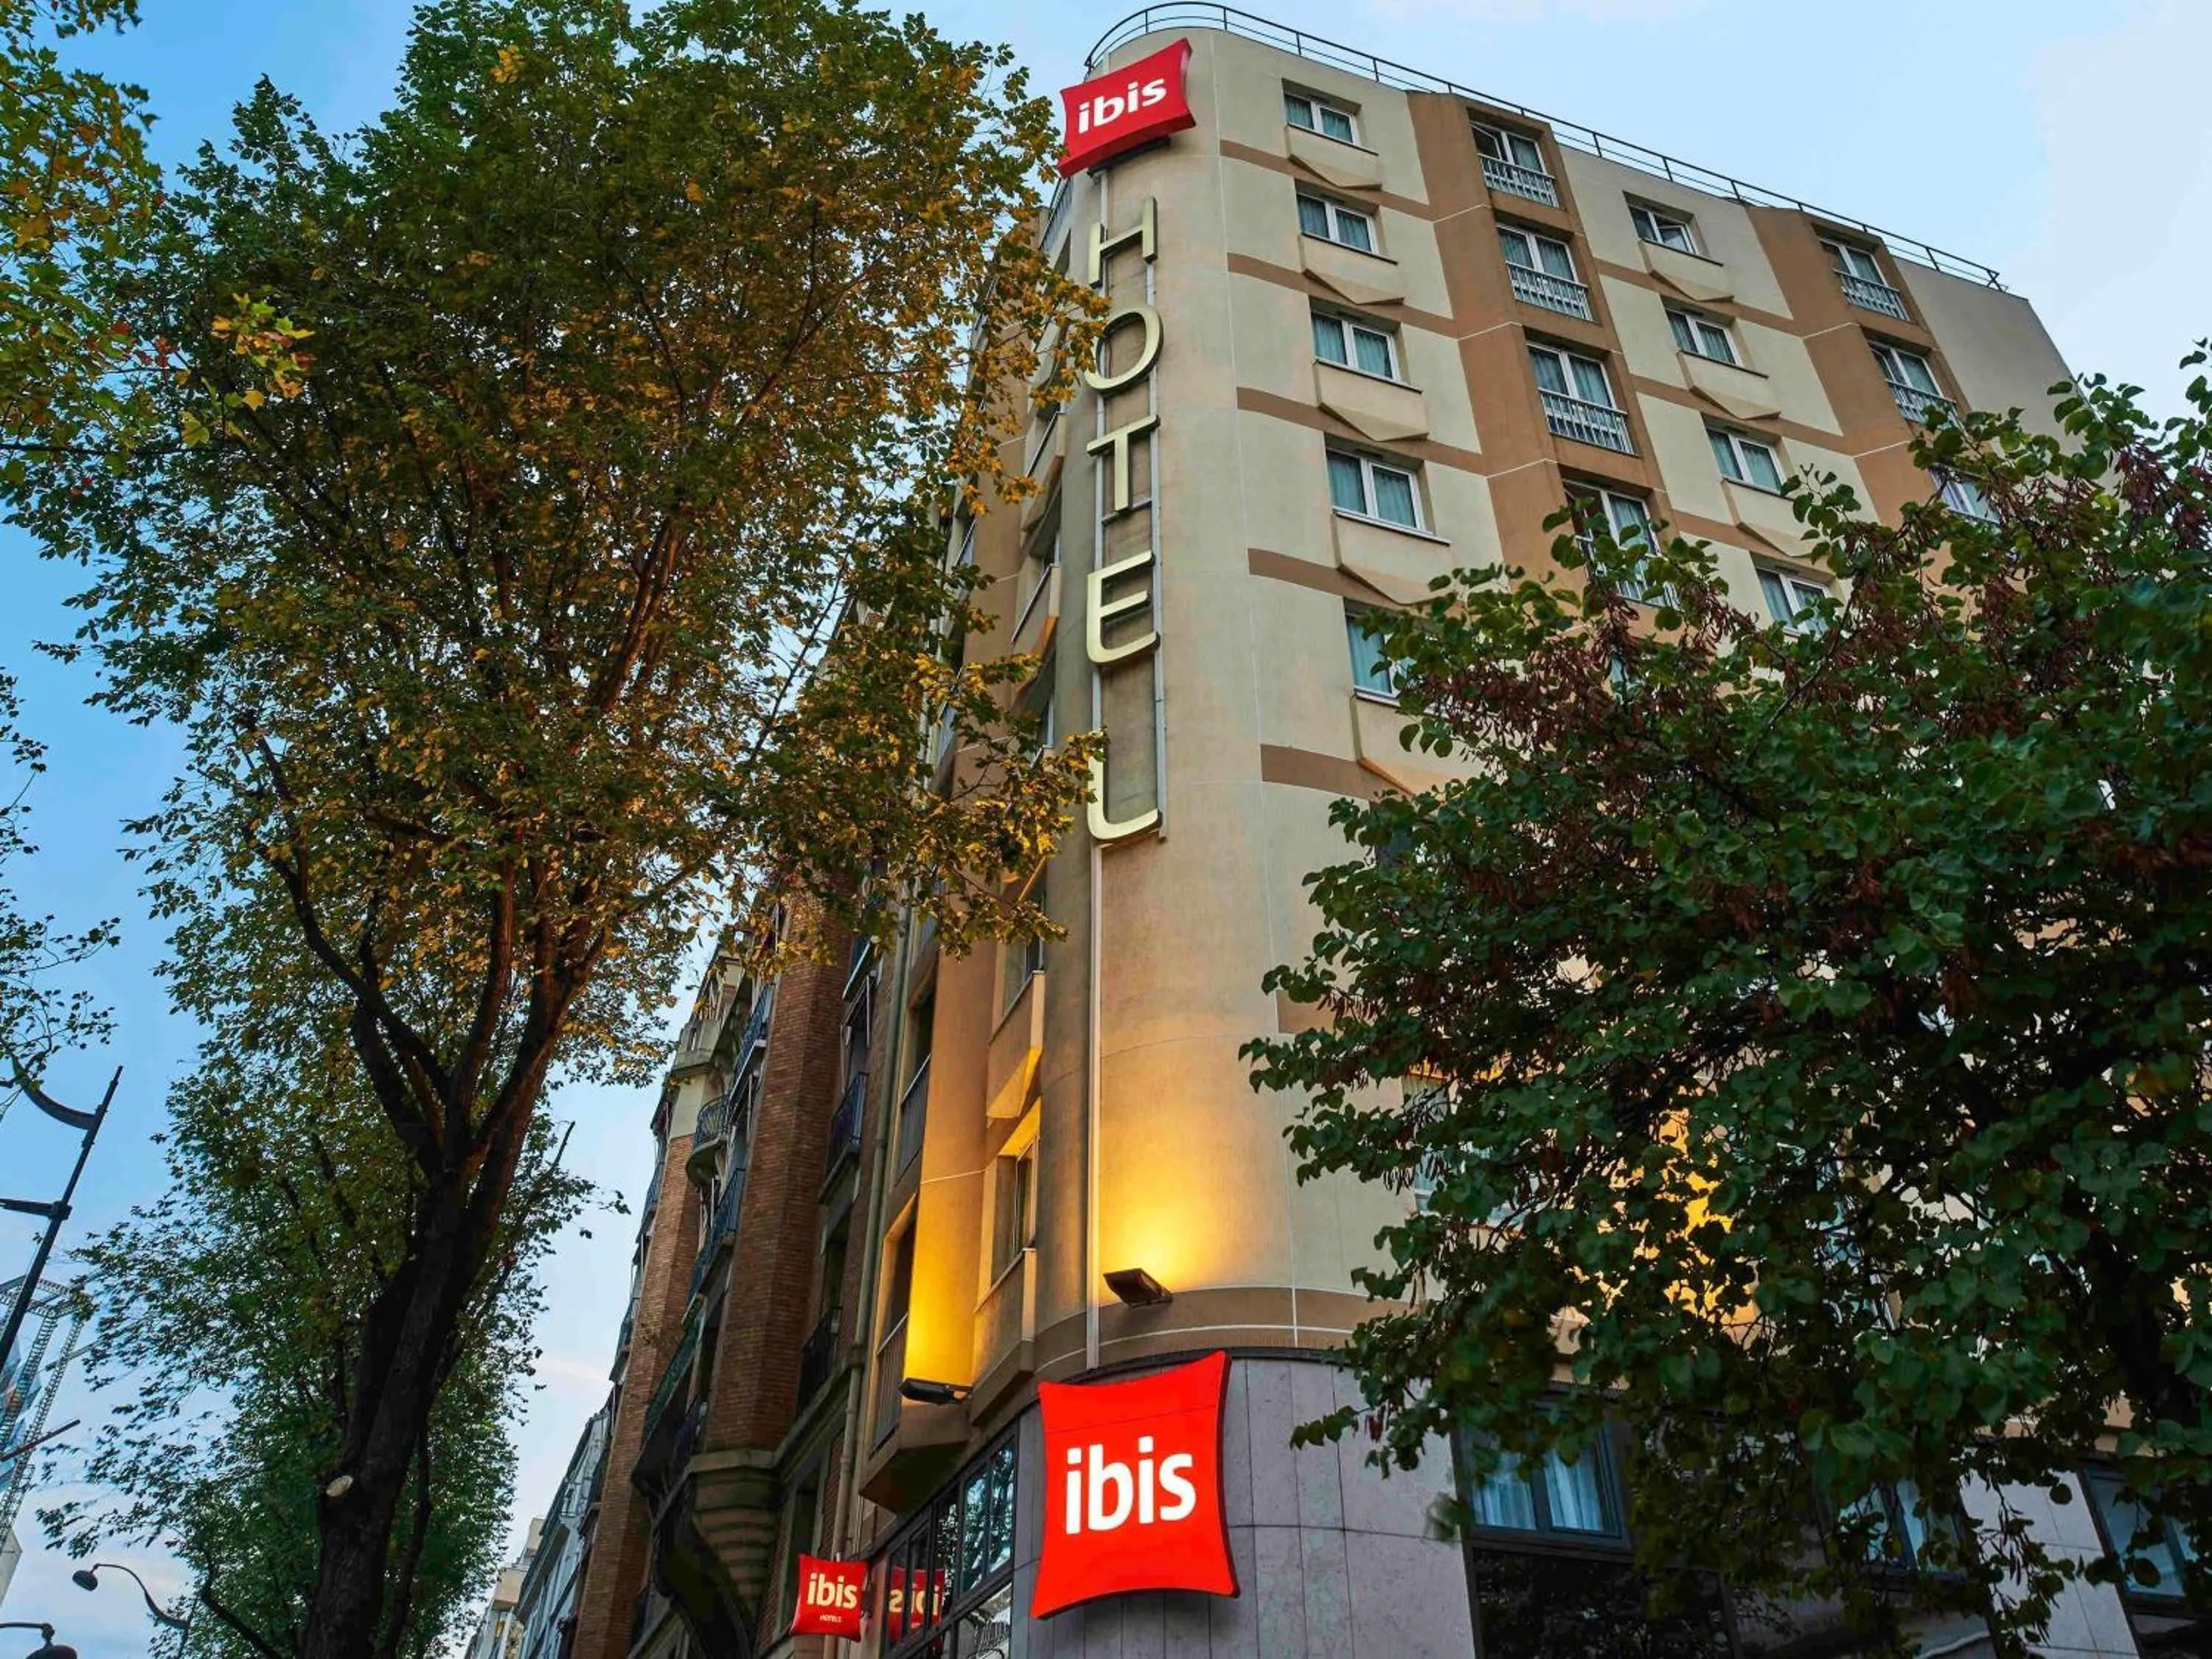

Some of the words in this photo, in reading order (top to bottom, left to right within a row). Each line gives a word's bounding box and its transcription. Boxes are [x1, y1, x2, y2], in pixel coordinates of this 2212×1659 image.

[1078, 78, 1167, 134] ibis
[1083, 195, 1164, 844] HOTEL
[1065, 1436, 1197, 1534] ibis
[807, 1573, 858, 1609] ibis
